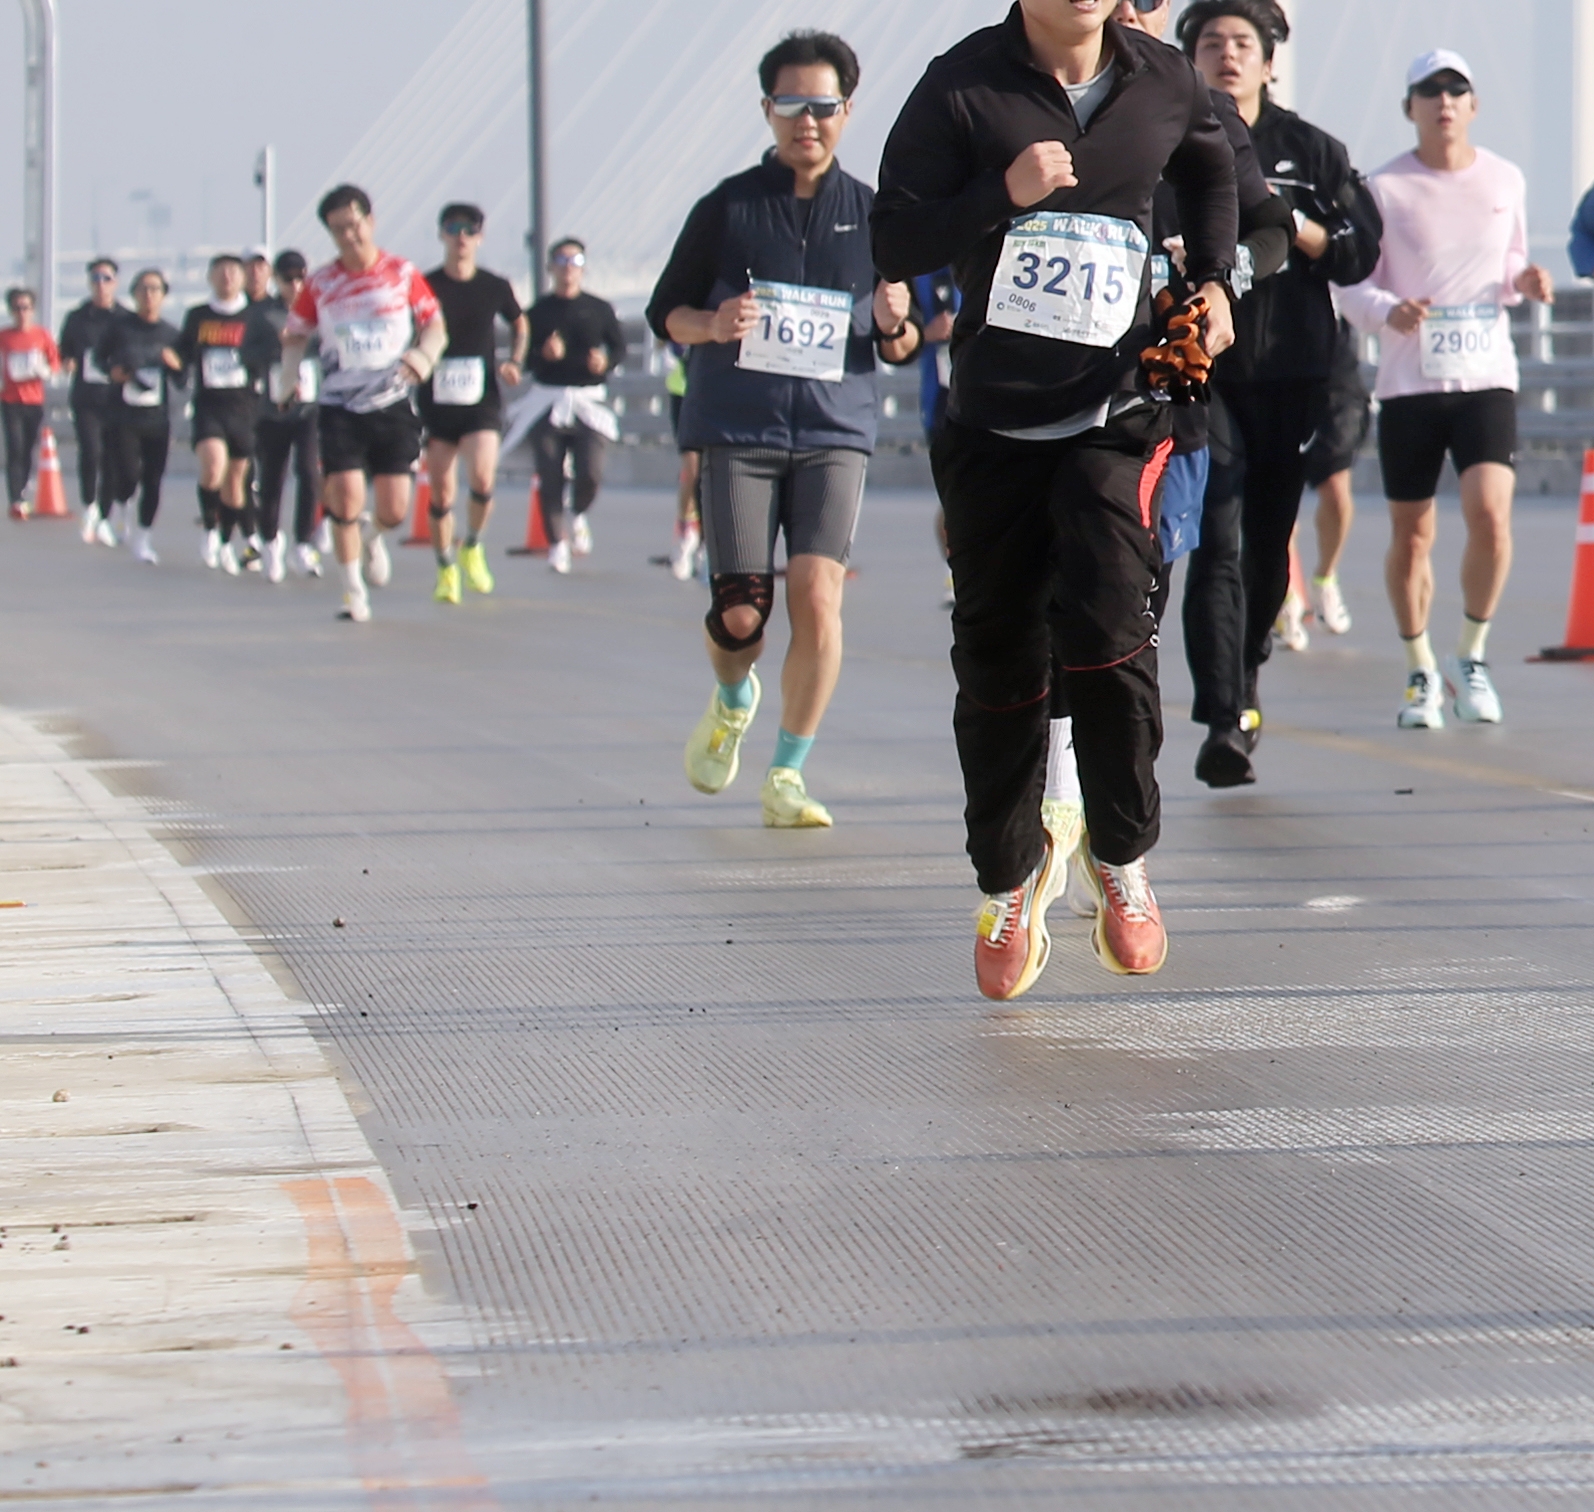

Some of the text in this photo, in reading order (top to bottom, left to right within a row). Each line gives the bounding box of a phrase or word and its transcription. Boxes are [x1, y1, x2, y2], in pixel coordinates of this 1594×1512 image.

[1012, 252, 1125, 305] 3215
[1008, 292, 1037, 313] 0806
[760, 315, 835, 351] 1692
[1431, 330, 1490, 354] 2900
